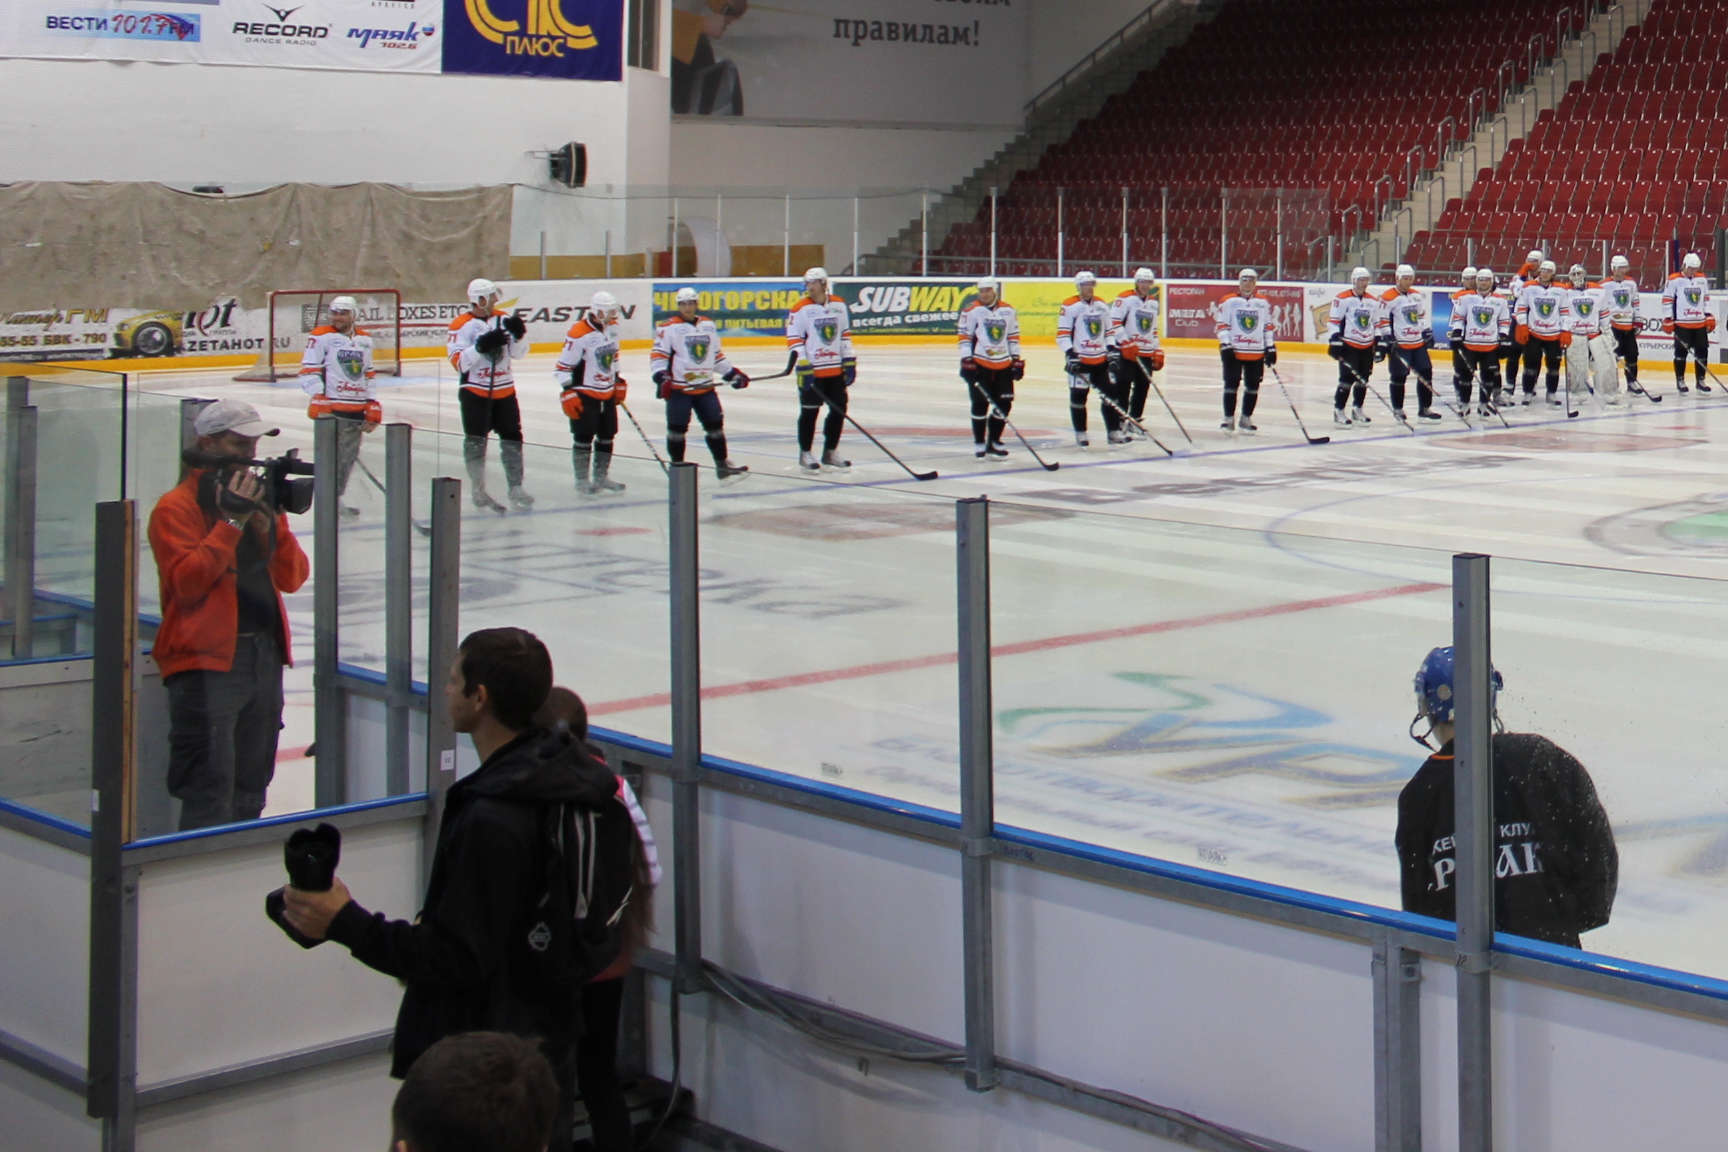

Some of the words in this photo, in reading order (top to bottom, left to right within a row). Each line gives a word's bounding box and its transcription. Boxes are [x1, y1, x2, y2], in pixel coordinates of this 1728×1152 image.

[46, 16, 108, 31] ВЕСТИ
[231, 21, 329, 38] RECORD
[833, 18, 981, 47] правилам!
[506, 35, 565, 57] ПЛЮС
[849, 284, 979, 314] SUBWAY
[513, 304, 636, 323] EASTN
[852, 315, 902, 328] всегда
[904, 311, 958, 323] свежее
[1175, 319, 1199, 327] Club
[1639, 342, 1675, 350] КУРЬЕРСКИ
[1500, 822, 1532, 837] КЛУ
[1427, 842, 1545, 892] РАК
